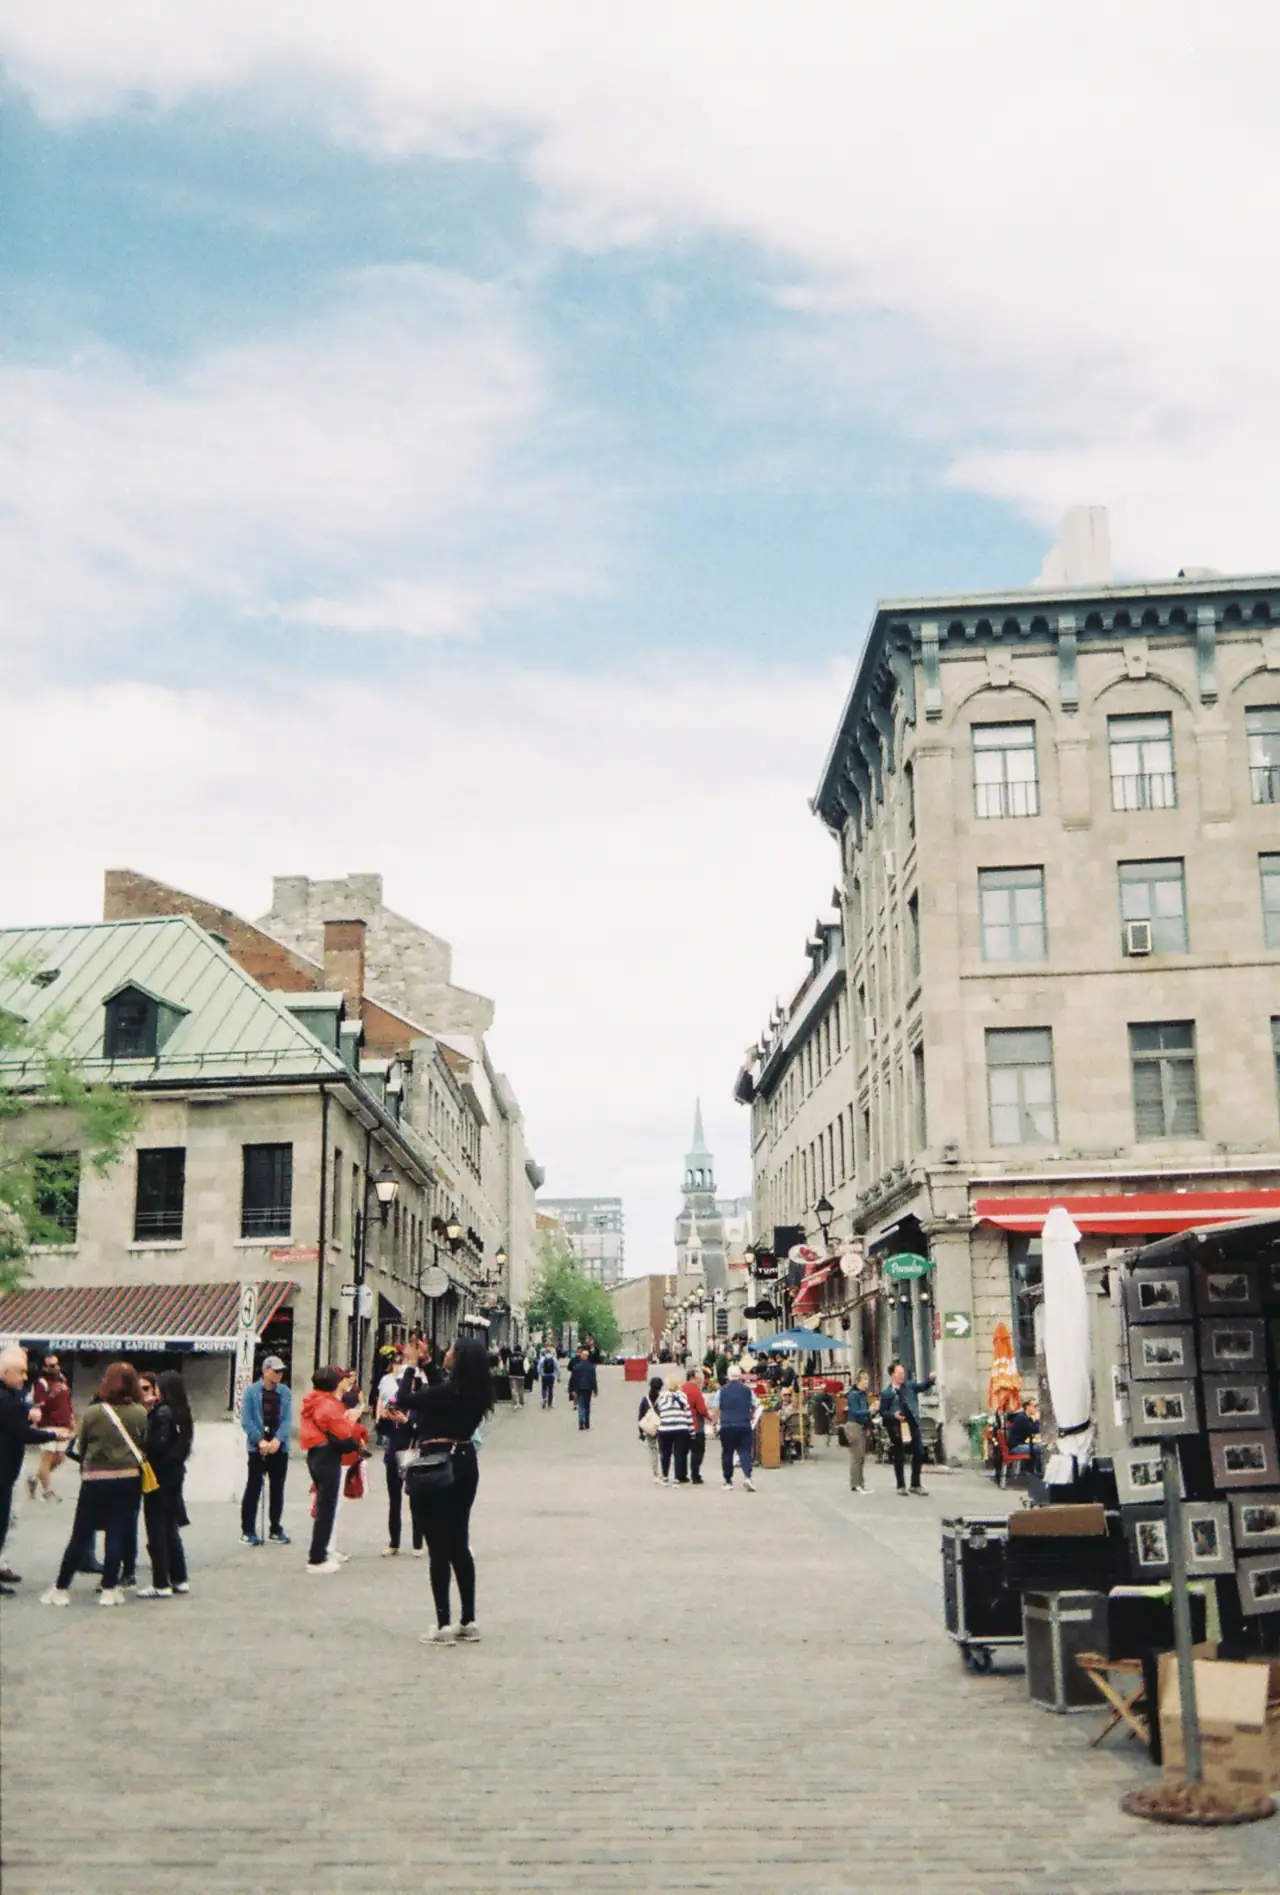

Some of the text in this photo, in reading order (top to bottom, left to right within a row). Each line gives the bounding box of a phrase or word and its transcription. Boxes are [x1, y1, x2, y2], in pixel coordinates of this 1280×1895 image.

[49, 1340, 165, 1351] PLACE JACQUES CARTIER
